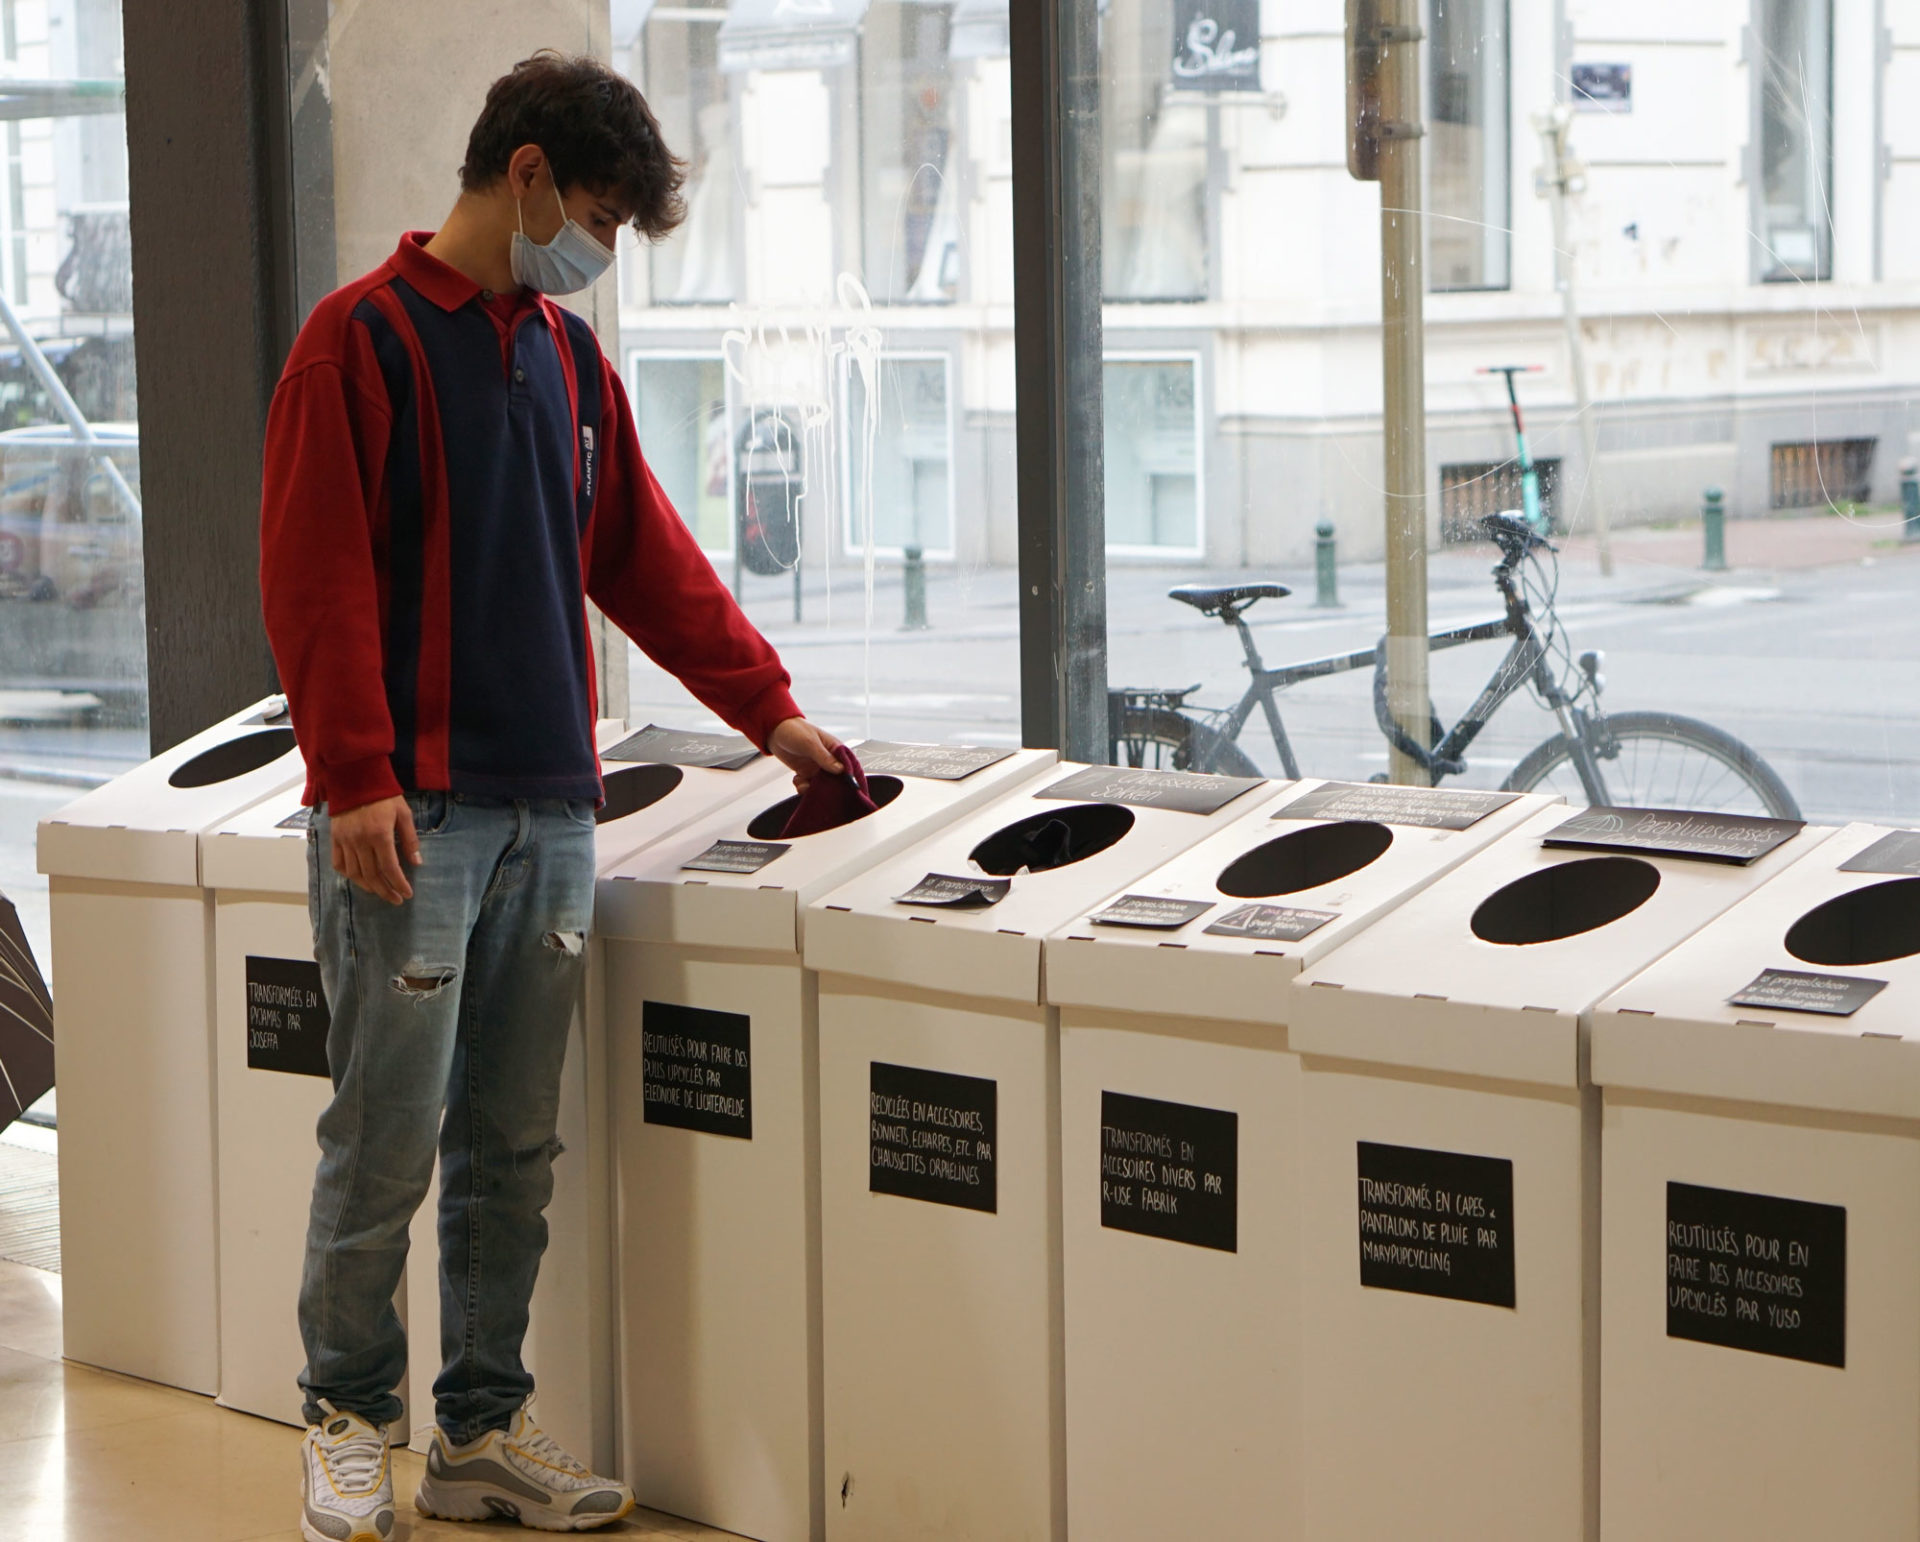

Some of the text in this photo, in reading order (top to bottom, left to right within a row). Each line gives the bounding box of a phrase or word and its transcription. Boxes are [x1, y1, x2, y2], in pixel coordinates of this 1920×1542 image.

[1090, 783, 1163, 801] Sokken
[1629, 812, 1780, 843] Parapluies cassés
[248, 982, 317, 1009] TRANSFORMÉES EN
[249, 1006, 302, 1031] PYJAMAS PAR
[687, 1039, 708, 1061] POUR
[711, 1043, 732, 1065] FAIRE
[735, 1048, 748, 1068] DES
[643, 1058, 721, 1087] PULLS UPCYCLÉS PAR
[684, 1089, 694, 1109] DE
[912, 1101, 926, 1122] EN
[976, 1141, 992, 1161] PAR
[1102, 1126, 1194, 1162] TRANSFORMÉS EN
[871, 1145, 980, 1185] CHAUSSETTES ORPHELINES
[1102, 1153, 1222, 1195] ACCESOIRES DIVERS PAR
[1103, 1180, 1178, 1214] R-USE FABRIK
[1358, 1177, 1432, 1210] TRANSFORMÉS
[1436, 1190, 1450, 1213] EN
[1456, 1193, 1486, 1218] CAPES
[1361, 1210, 1498, 1249] PANTALONS DE PLUIE PAR
[1668, 1220, 1809, 1268] REUTILISÉS POUR EN
[1668, 1253, 1803, 1298] FAIRE DES ACCESOIRES
[1669, 1286, 1800, 1329] UPCYCLÉS PAR YUSO
